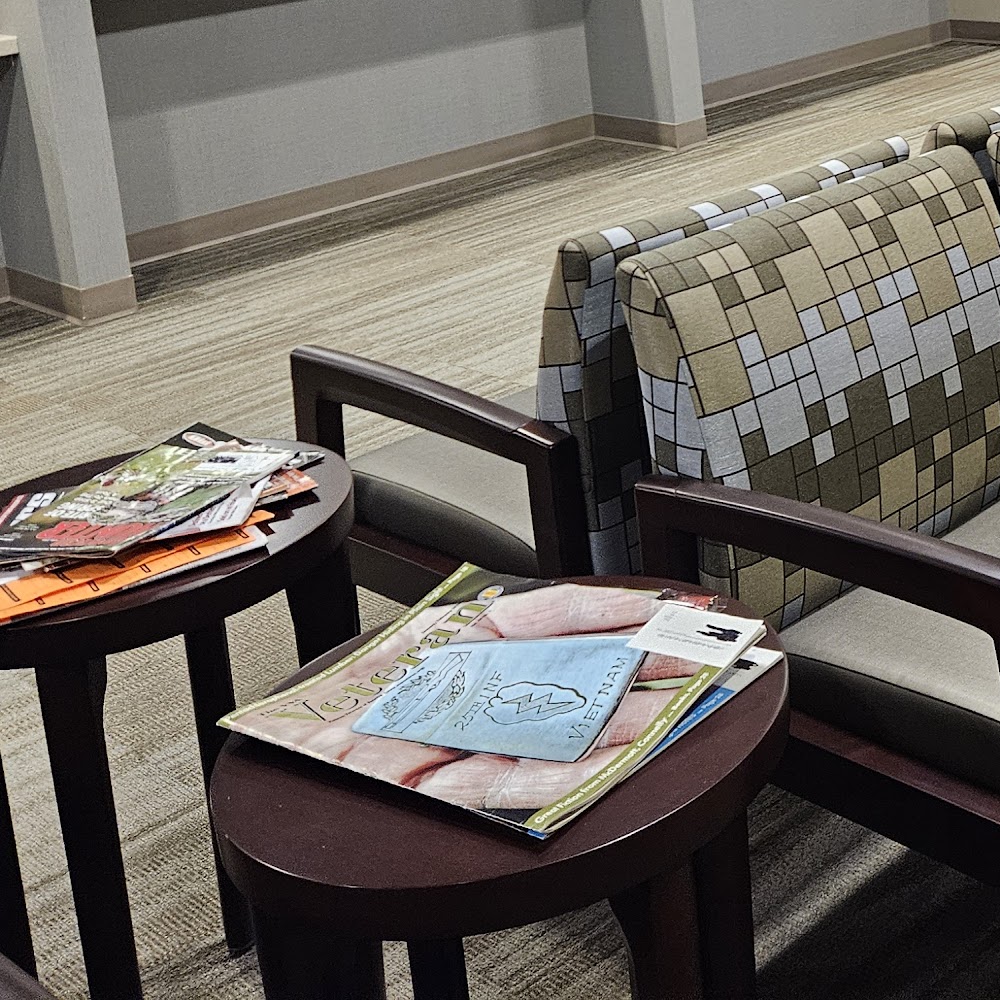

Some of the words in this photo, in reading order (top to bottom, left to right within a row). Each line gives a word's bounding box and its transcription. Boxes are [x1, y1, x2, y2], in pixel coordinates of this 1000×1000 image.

[270, 602, 489, 722] Veteran
[534, 804, 560, 824] Great
[556, 791, 584, 809] Fiction
[579, 778, 601, 796] from
[598, 747, 641, 780] McDermott,
[636, 716, 668, 747] Connelly
